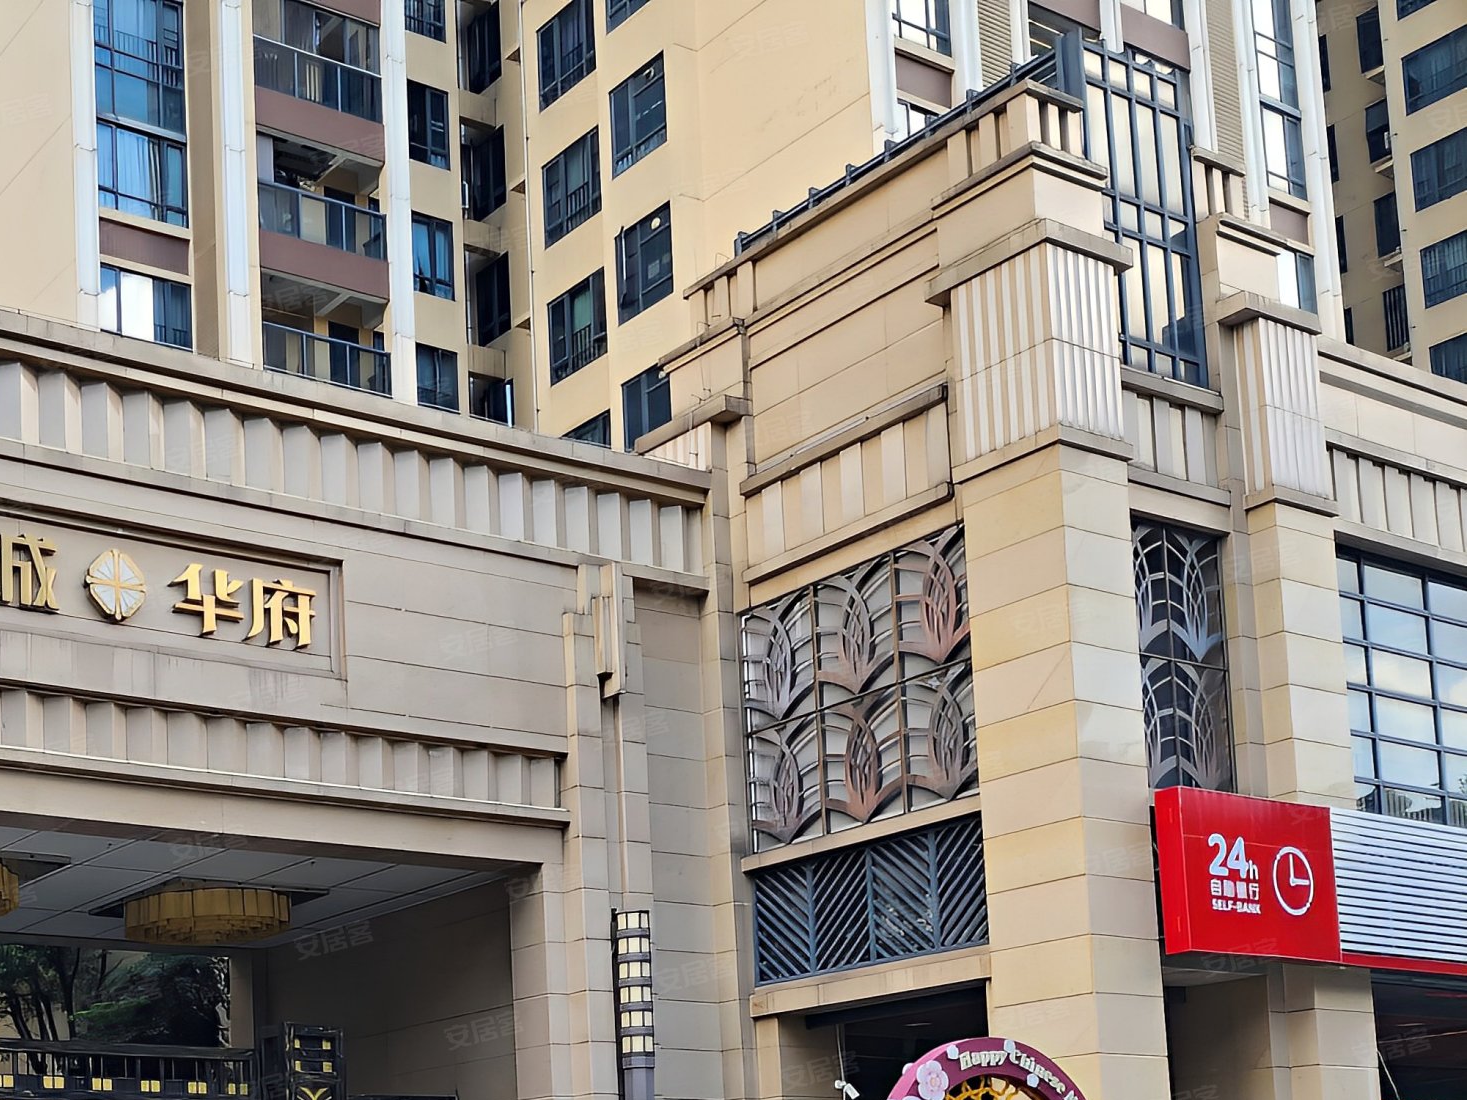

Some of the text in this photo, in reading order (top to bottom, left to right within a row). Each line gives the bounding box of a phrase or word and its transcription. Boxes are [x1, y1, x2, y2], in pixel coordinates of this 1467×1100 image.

[167, 562, 317, 650] 华府
[1207, 832, 1259, 880] 24h
[958, 1050, 1009, 1071] Happy
[1009, 1049, 1066, 1095] Chinese
